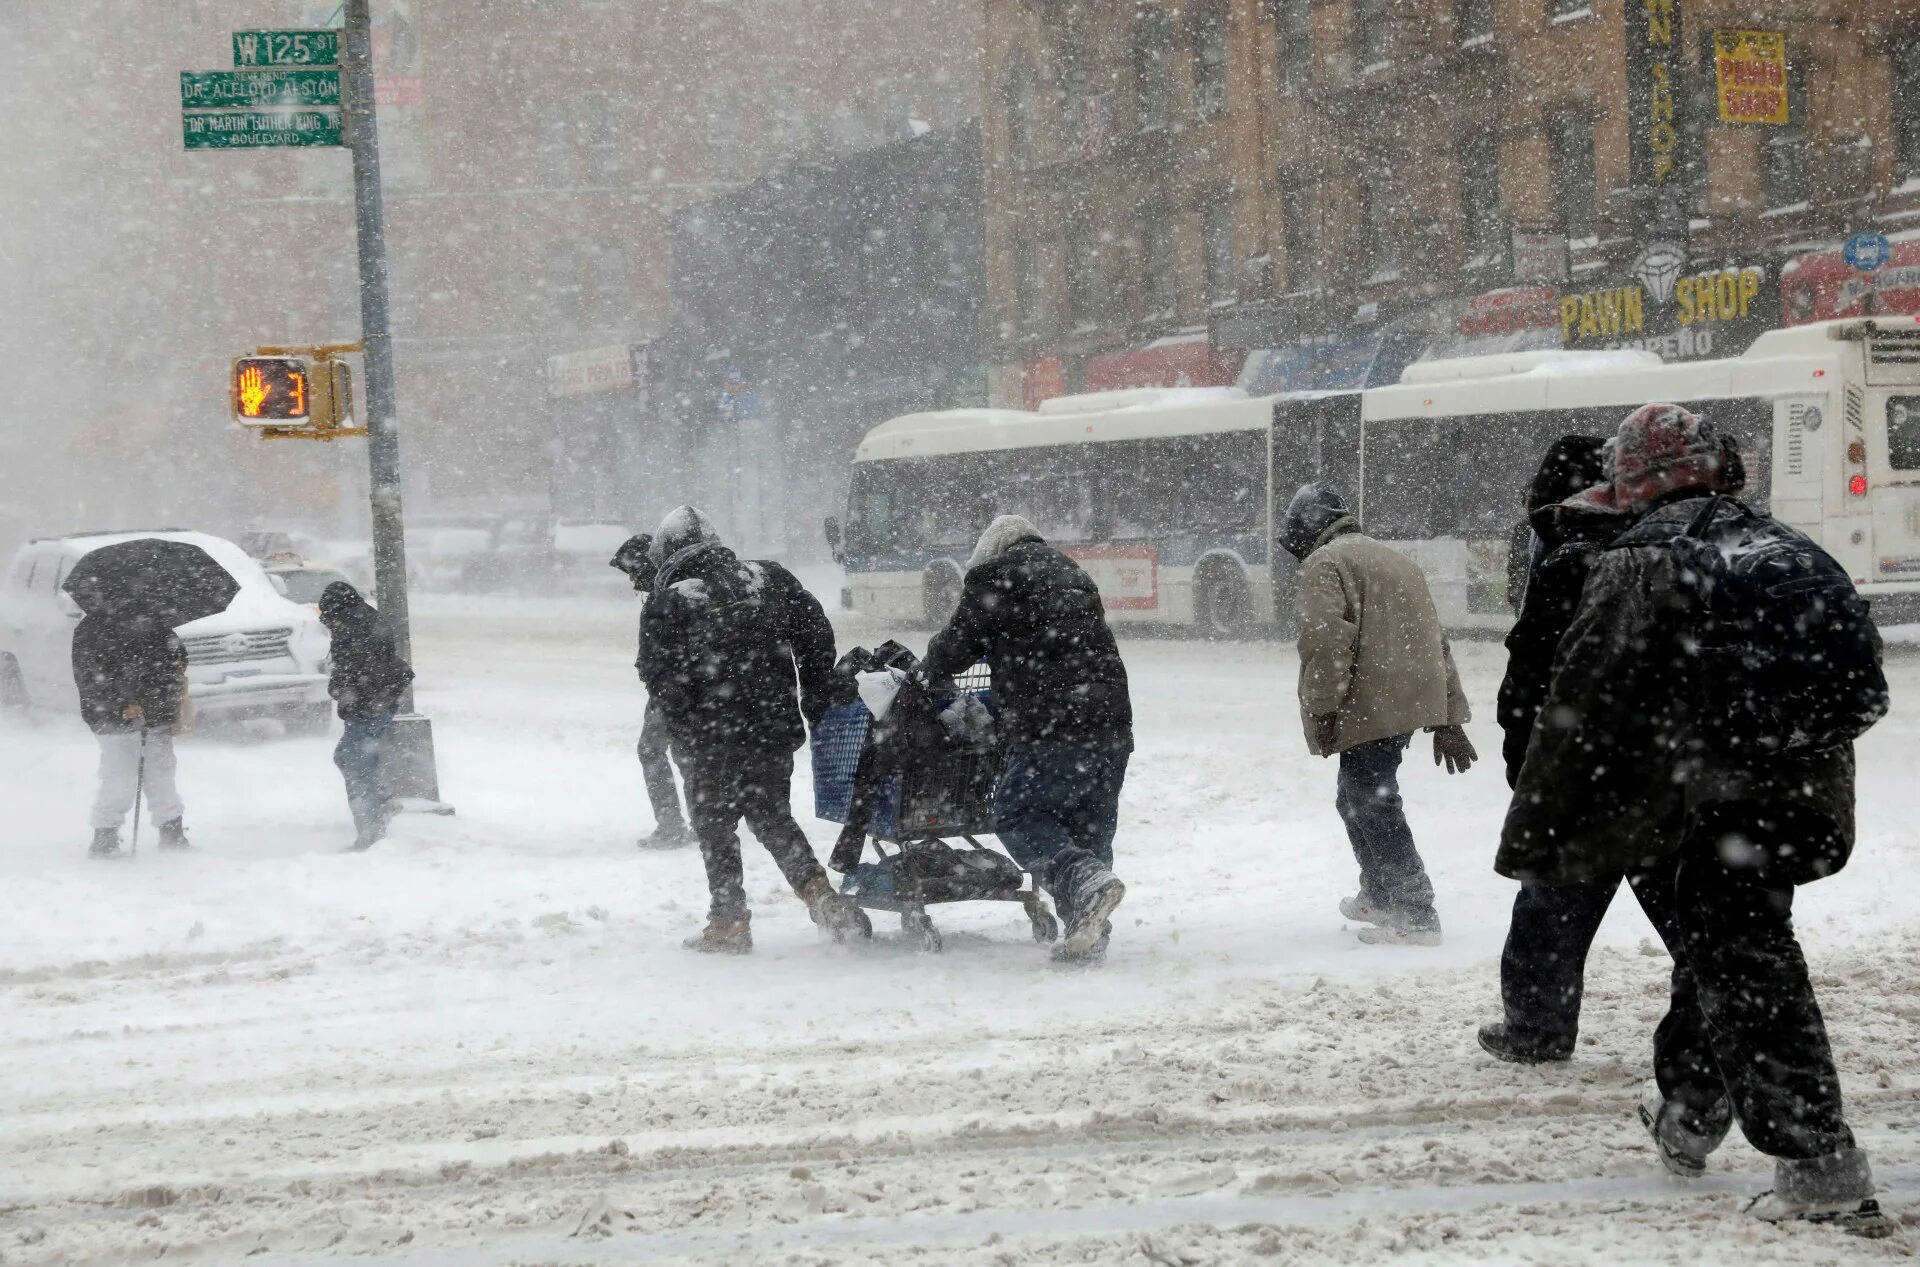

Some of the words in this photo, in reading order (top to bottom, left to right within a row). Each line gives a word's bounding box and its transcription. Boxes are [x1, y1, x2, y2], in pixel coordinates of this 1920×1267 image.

[237, 35, 258, 64] W
[266, 35, 310, 63] 125
[316, 34, 334, 50] ST
[284, 80, 337, 97] ALSTON
[189, 117, 205, 132] DR
[209, 116, 248, 131] MARTIN
[252, 115, 292, 131] LUTHER
[326, 114, 340, 130] JR
[231, 134, 299, 145] BOULEVARD
[1561, 287, 1644, 341] PAWN
[1675, 269, 1760, 326] SHOP
[288, 372, 304, 415] 3
